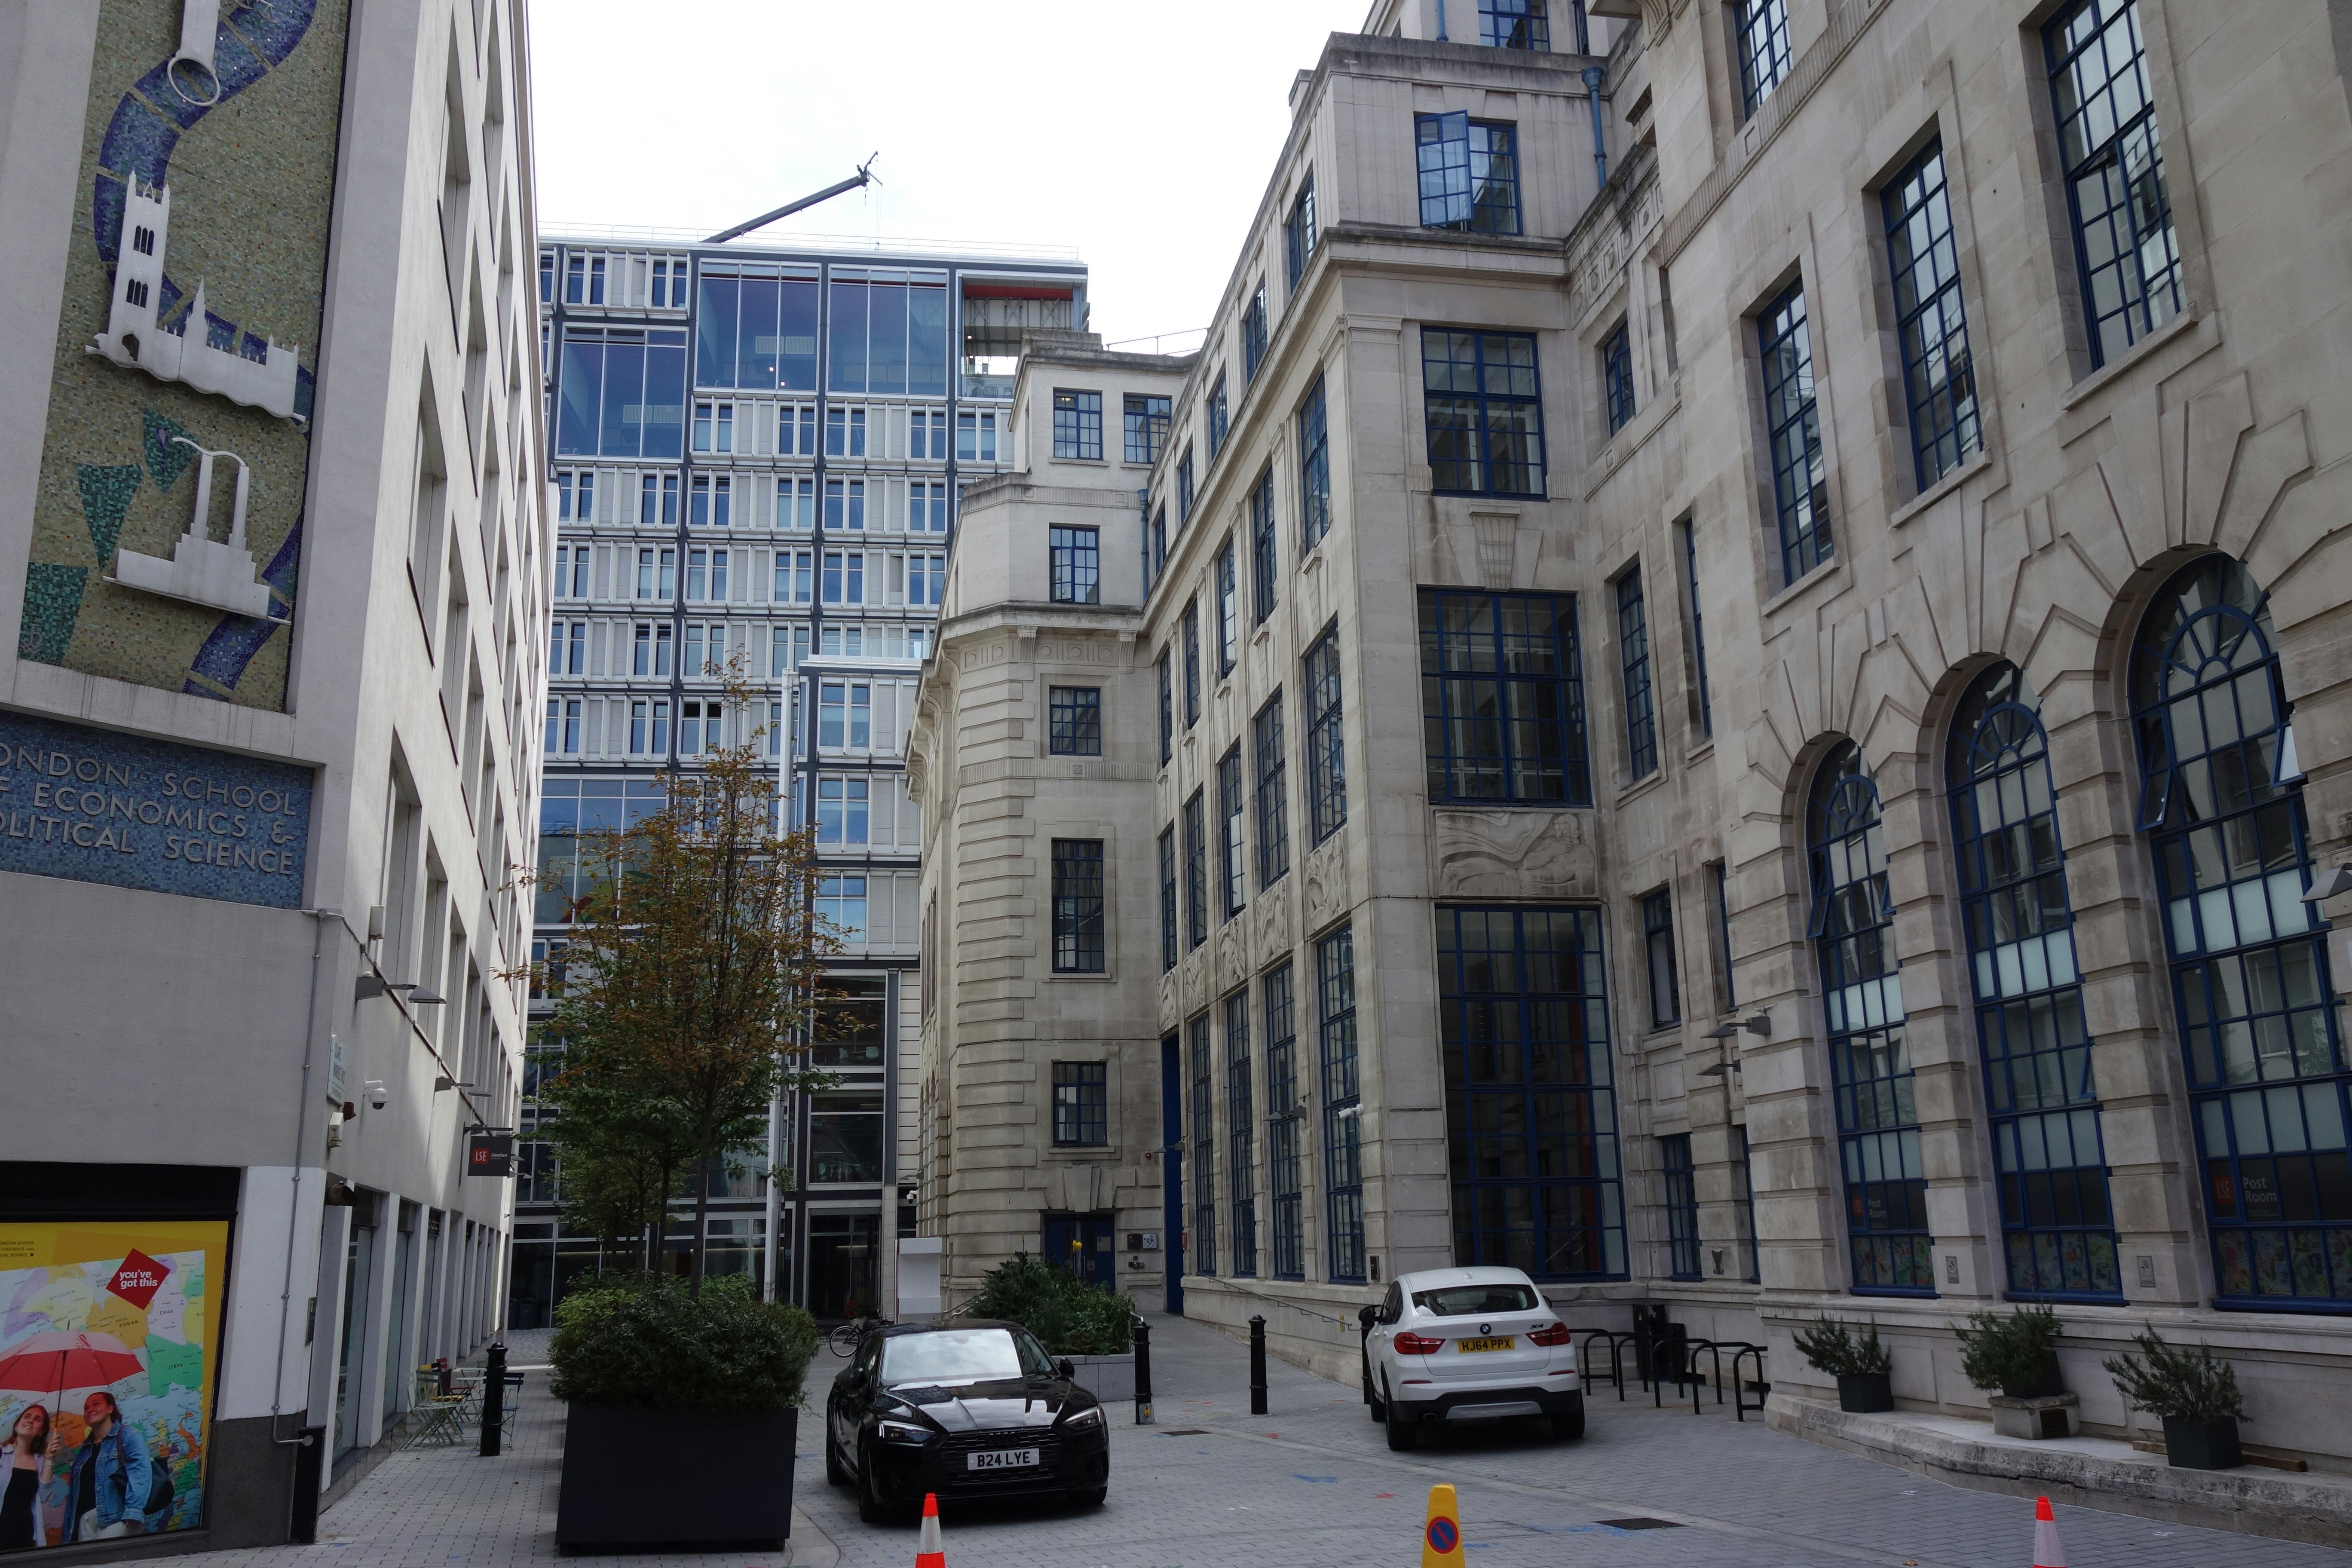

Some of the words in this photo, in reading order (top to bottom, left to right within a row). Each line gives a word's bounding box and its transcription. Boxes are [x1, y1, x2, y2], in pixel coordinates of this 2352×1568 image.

[162, 773, 296, 816] SCHOOL
[34, 782, 247, 837] ECONOMICS
[271, 821, 294, 844] &
[0, 811, 135, 853] LITICAL
[164, 836, 293, 875] SCIENCE
[475, 1151, 487, 1161] LSE
[2242, 1177, 2267, 1189] Post
[2216, 1181, 2231, 1198] LSE
[2244, 1191, 2277, 1202] Room
[1868, 1199, 1881, 1208] Post
[1869, 1209, 1886, 1218] Room
[119, 1269, 151, 1281] you've
[121, 1280, 138, 1289] got
[139, 1278, 158, 1287] this
[1462, 1340, 1488, 1351] HJ64
[1491, 1338, 1511, 1349] PPX
[977, 1454, 1002, 1467] B24
[1006, 1451, 1030, 1465] LYE
